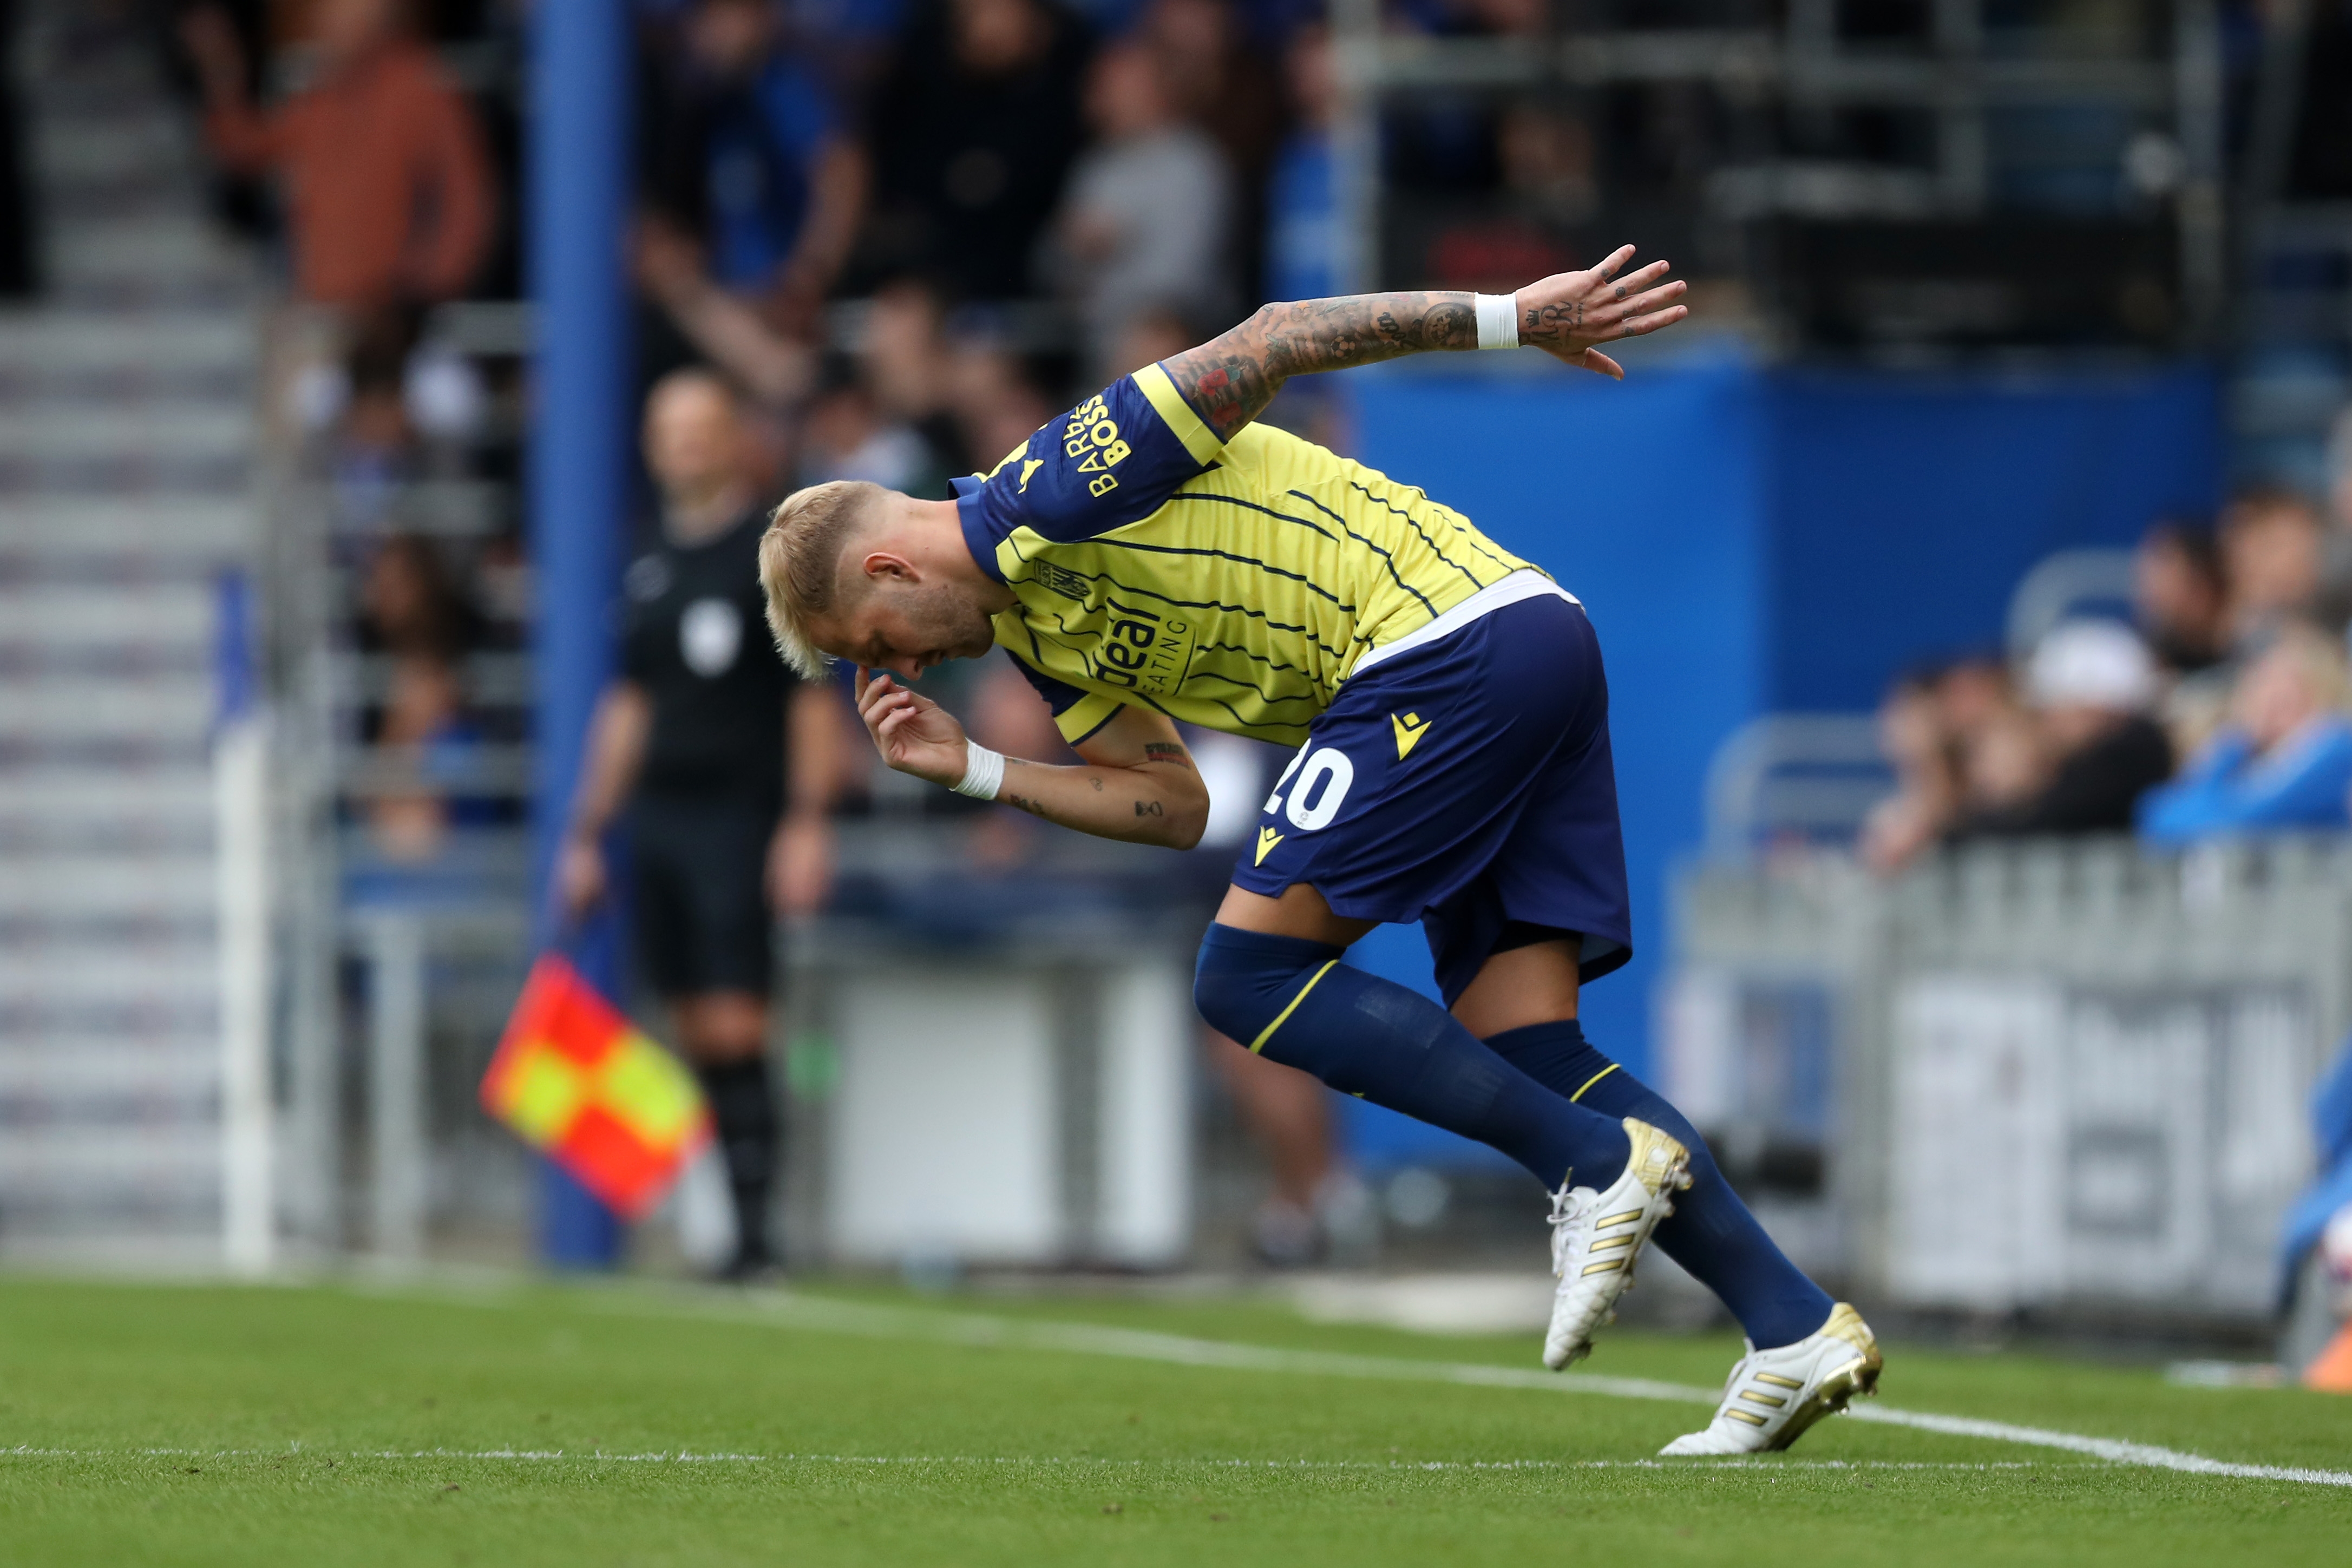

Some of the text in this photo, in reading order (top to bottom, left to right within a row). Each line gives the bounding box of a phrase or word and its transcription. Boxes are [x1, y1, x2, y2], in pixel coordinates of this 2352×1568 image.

[1080, 395, 1132, 467] BOSS
[1093, 596, 1161, 687] deal
[1142, 620, 1187, 694] EATING
